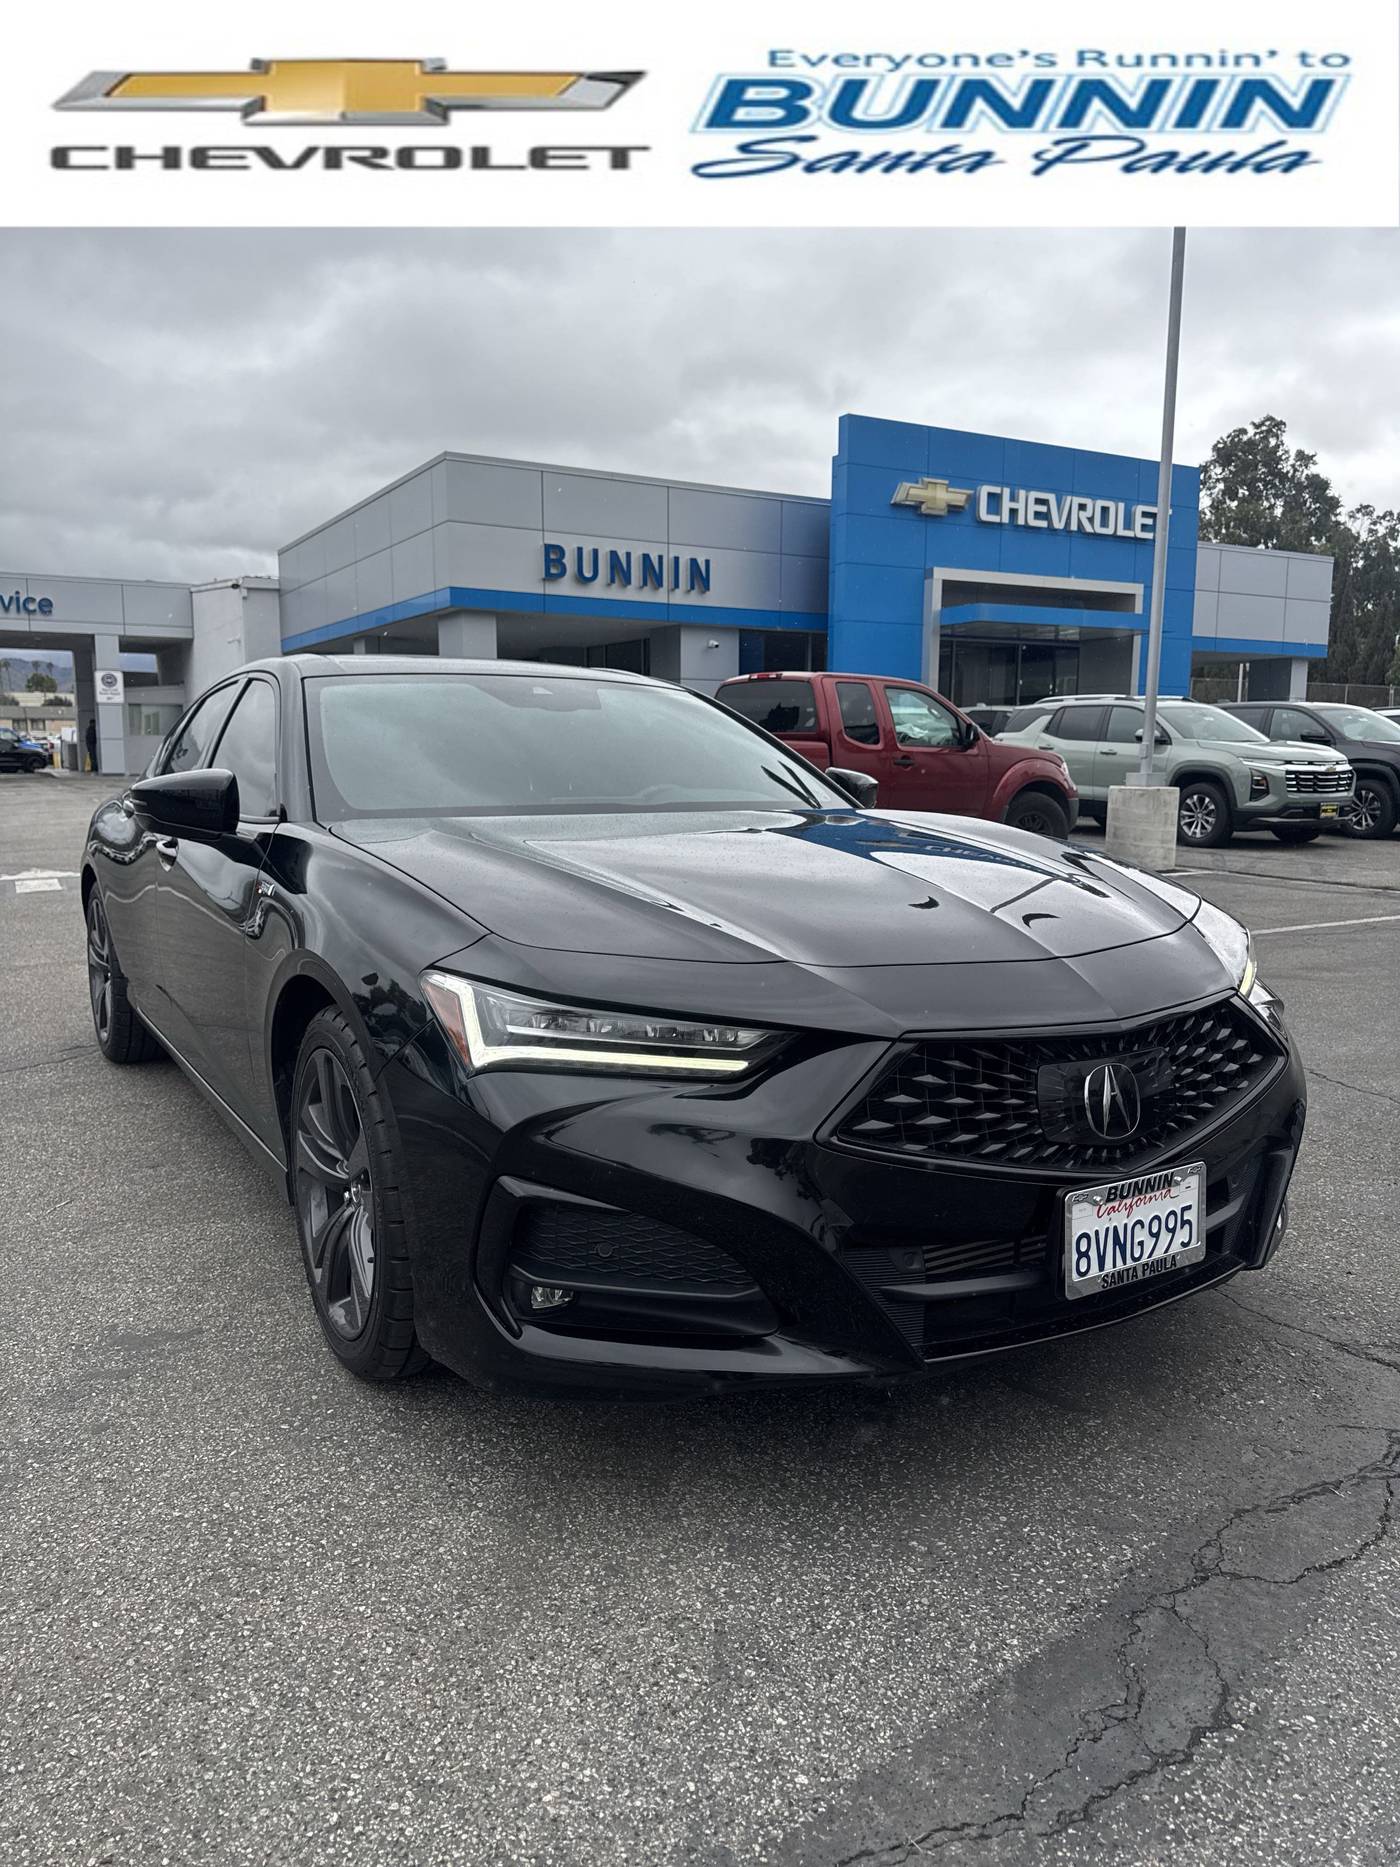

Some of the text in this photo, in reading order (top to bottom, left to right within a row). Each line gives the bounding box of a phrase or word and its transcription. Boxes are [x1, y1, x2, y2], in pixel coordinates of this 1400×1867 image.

[976, 484, 1172, 540] CHEVROLE
[543, 543, 711, 593] BUNNIN
[1096, 1188, 1180, 1219] California
[1105, 1172, 1174, 1203] BUNNIN
[1075, 1204, 1193, 1277] 8VNG995
[1101, 1254, 1177, 1290] SANTA PAULA
